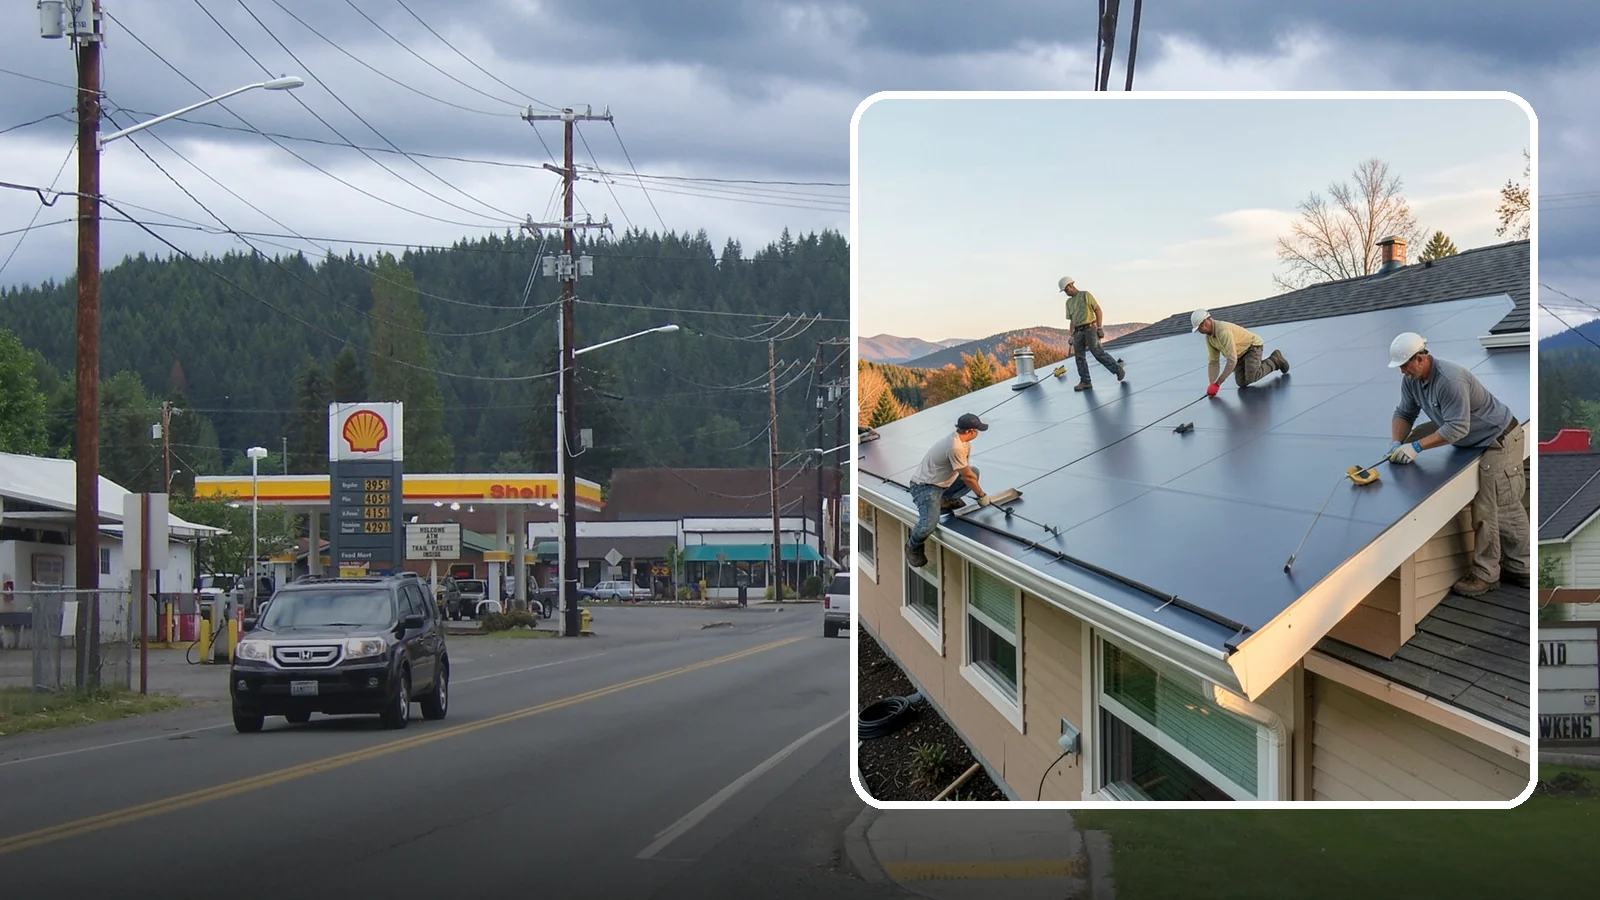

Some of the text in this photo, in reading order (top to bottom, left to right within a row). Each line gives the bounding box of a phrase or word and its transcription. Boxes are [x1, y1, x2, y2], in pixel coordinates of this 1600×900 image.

[342, 480, 383, 490] Regular 395
[490, 485, 547, 499] Shell
[366, 494, 383, 504] 405
[366, 508, 383, 518] 415
[366, 522, 383, 533] 429
